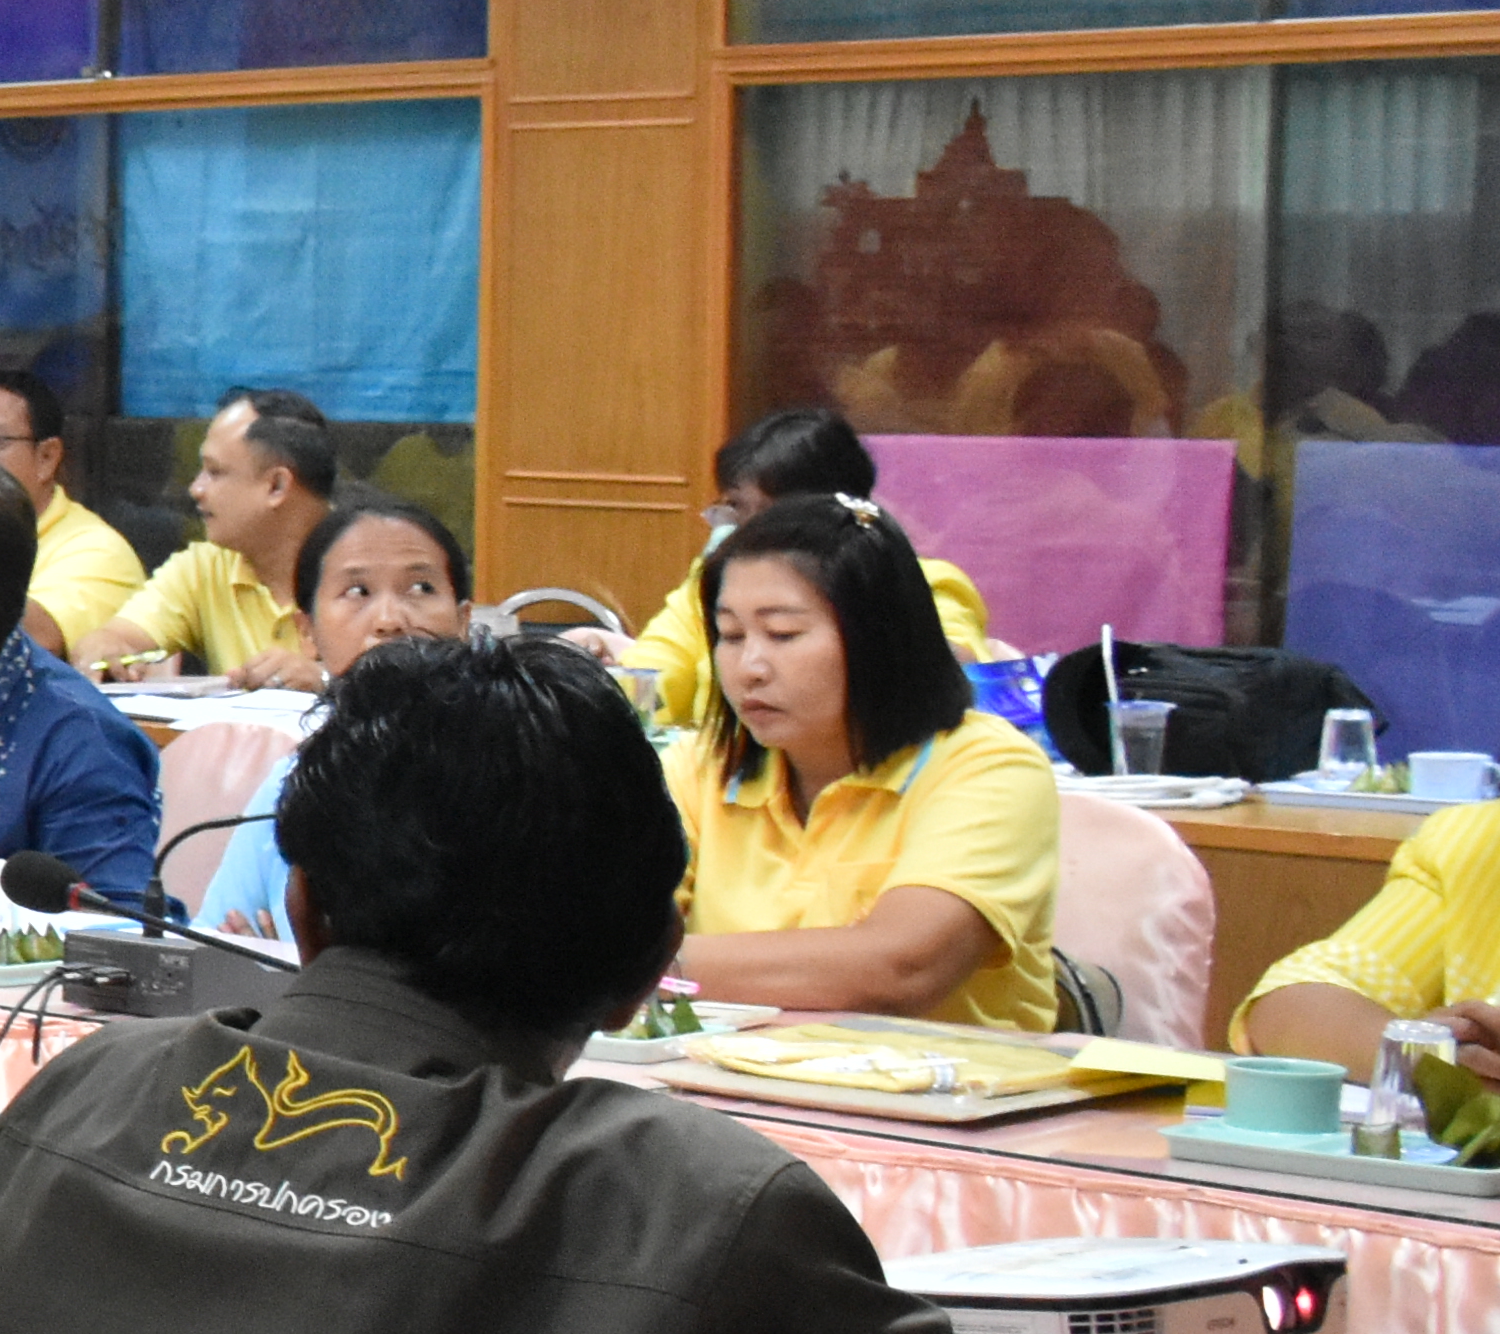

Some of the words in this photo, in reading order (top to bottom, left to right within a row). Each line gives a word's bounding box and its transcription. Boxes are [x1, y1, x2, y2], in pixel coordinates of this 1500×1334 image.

[149, 1159, 393, 1228] กรมการปกครอง
